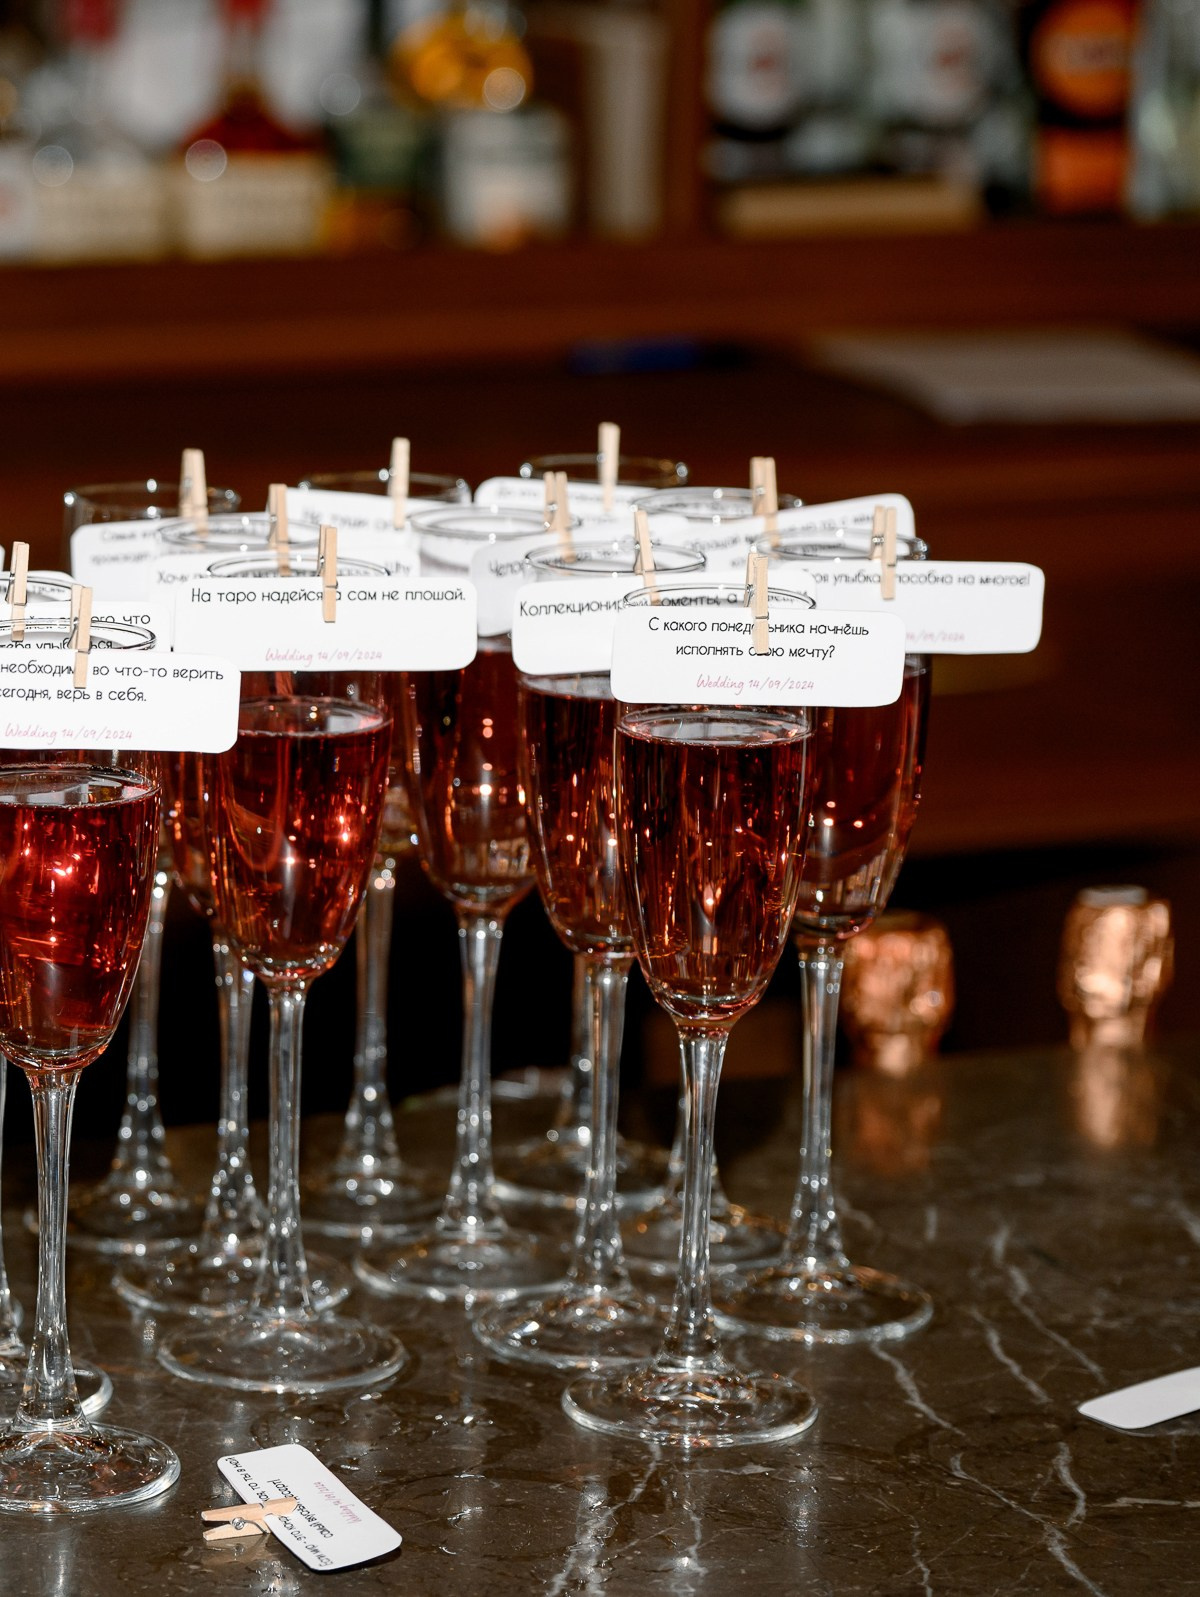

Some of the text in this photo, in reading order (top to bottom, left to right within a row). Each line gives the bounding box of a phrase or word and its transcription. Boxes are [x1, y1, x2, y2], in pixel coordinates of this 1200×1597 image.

[834, 570, 881, 586] улыбка
[896, 569, 954, 585] пособна
[958, 574, 975, 585] на
[191, 588, 211, 602] На
[217, 591, 257, 604] таро
[347, 590, 377, 601] сам
[382, 591, 399, 601] не
[405, 588, 466, 601] плошай.
[123, 614, 151, 625] что
[648, 616, 869, 635] С какого понедьника начнёшь
[265, 648, 383, 667] Wedding 14/09/2024
[676, 645, 836, 660] исполнять сою мечту?
[1, 660, 75, 676] необходим
[92, 666, 110, 676] во
[115, 666, 167, 678] что-то
[173, 668, 224, 681] верить
[696, 674, 814, 695] Wedding 14/09/2024
[57, 688, 90, 702] верь
[96, 690, 103, 700] в
[108, 687, 147, 702] себя.
[5, 723, 133, 745] Wedding 14/09/2024
